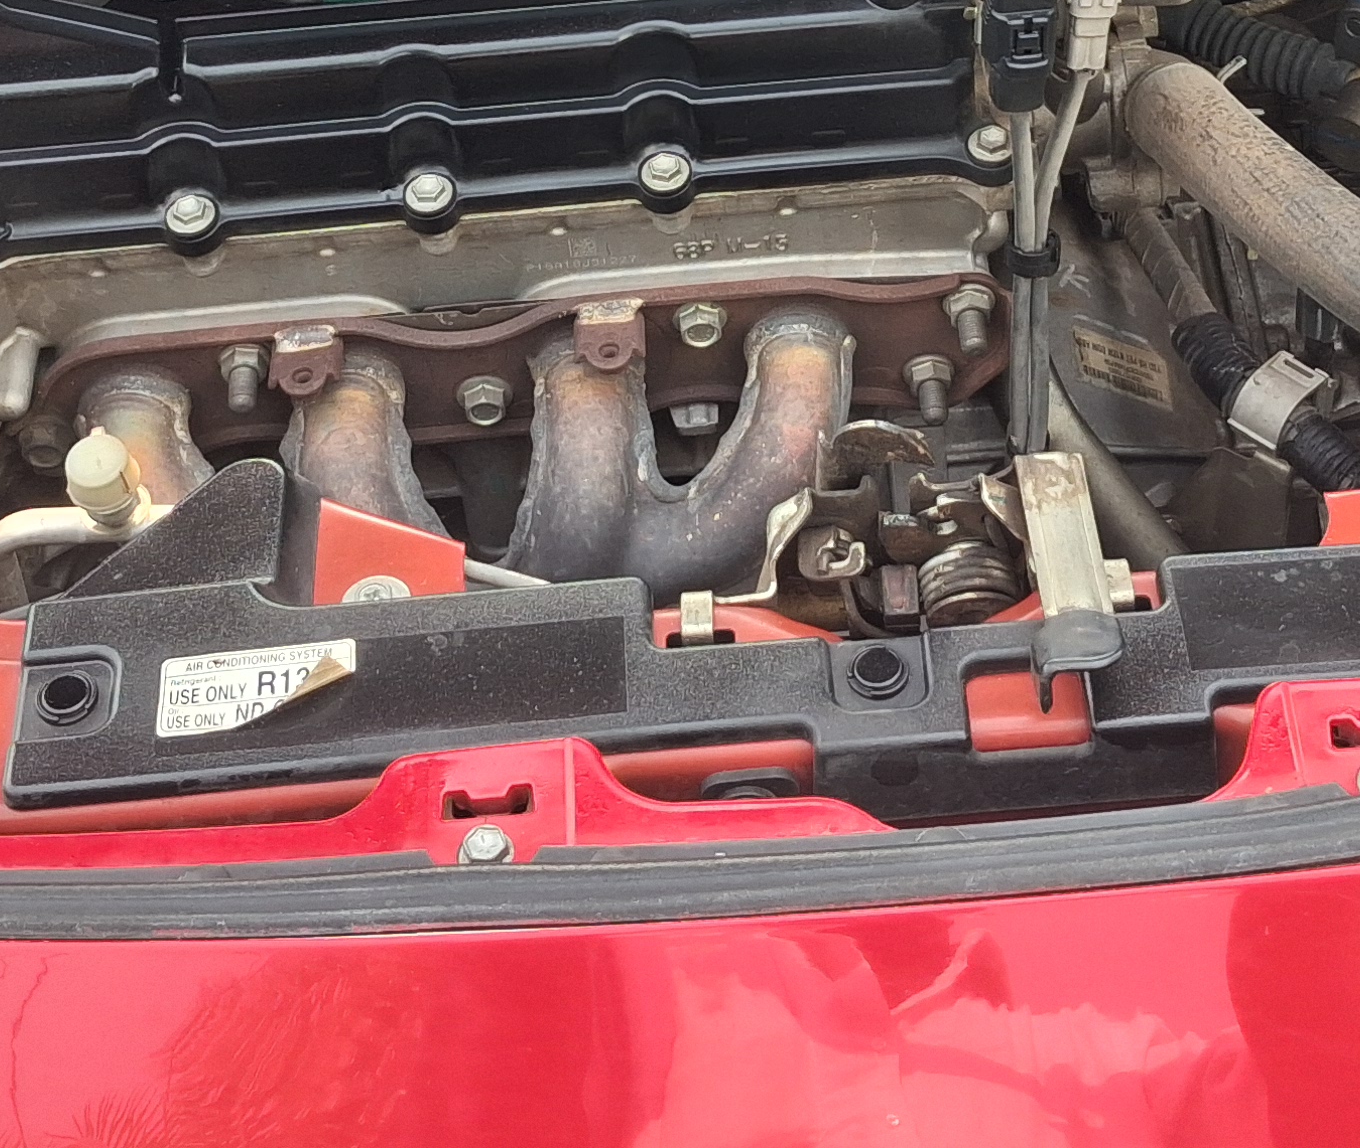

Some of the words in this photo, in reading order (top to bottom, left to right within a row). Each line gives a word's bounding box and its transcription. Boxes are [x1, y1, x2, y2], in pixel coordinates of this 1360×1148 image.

[185, 660, 204, 672] AIR
[206, 652, 286, 670] CONDITIONING
[290, 647, 333, 661] SYSTEM
[169, 688, 201, 706] USE
[205, 683, 248, 702] ONLY
[166, 714, 191, 729] USE
[194, 712, 227, 727] ONLY
